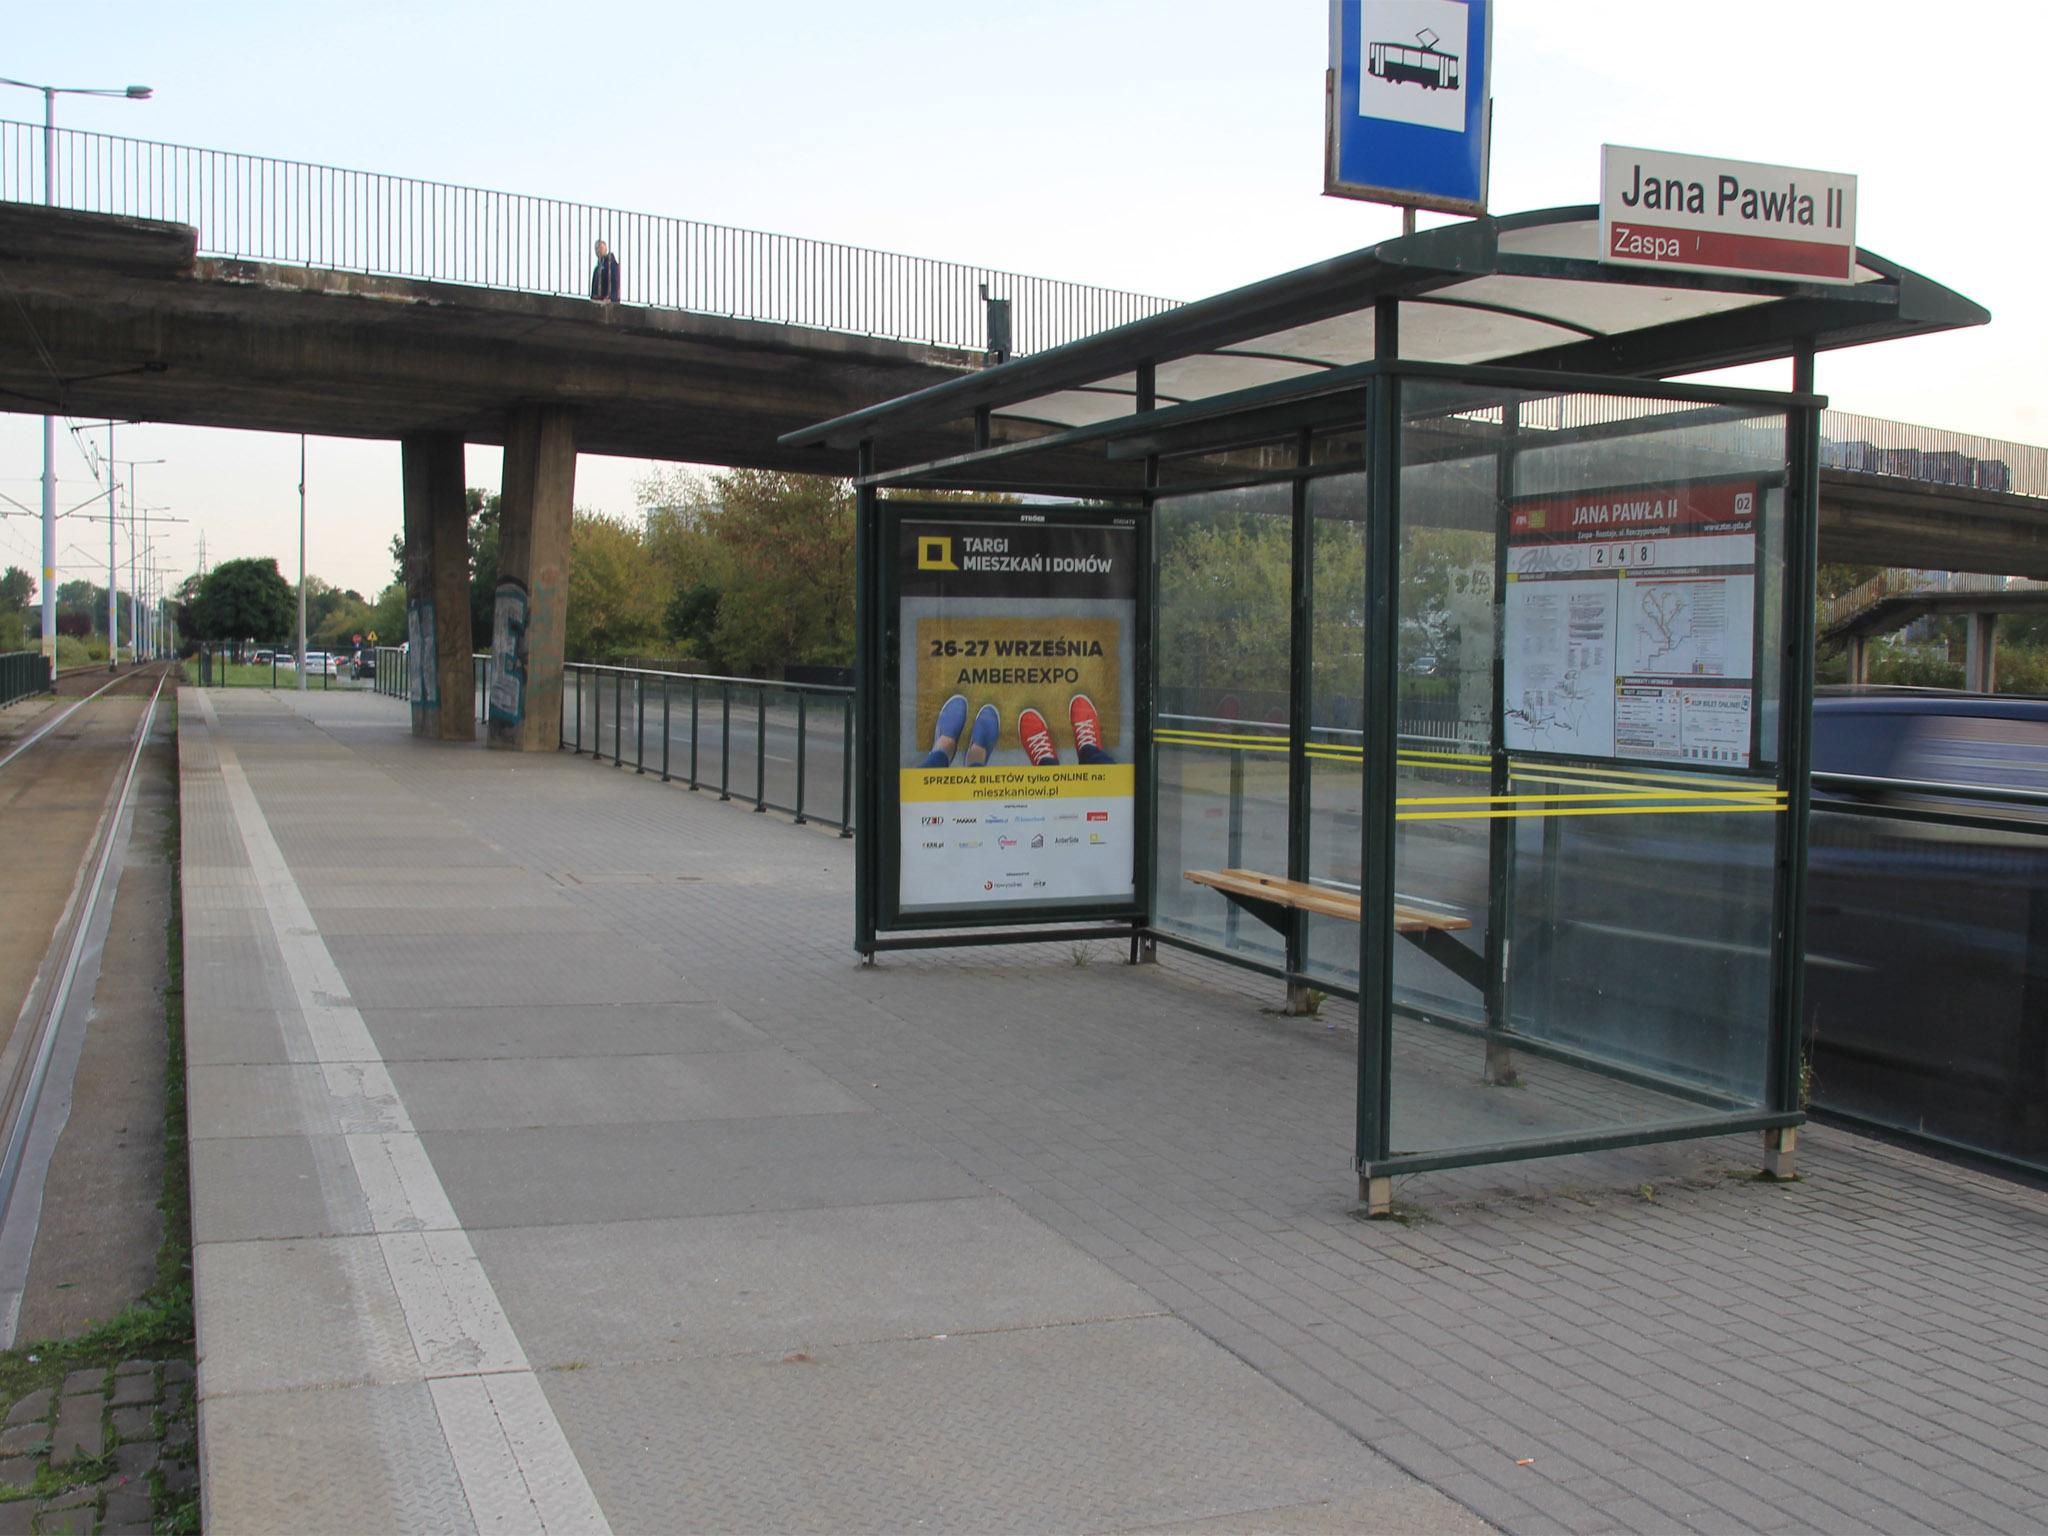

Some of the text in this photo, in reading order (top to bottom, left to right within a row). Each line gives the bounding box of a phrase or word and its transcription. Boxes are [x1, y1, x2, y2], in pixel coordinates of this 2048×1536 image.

[1621, 164, 1843, 229] Jana Pawła II
[1614, 227, 1681, 260] Zaspa
[1572, 499, 1678, 526] JANA PAWŁA II
[1736, 497, 1751, 511] 02
[963, 537, 1009, 553] TARGI
[963, 553, 1113, 574] MIESZKAŃ I DOMÓW
[1596, 549, 1604, 564] 2
[1618, 548, 1625, 563] 4
[1640, 546, 1648, 562] 8
[930, 636, 1104, 658] 26-27 WRZEŚNIA
[957, 667, 1080, 685] AMBEREXPO
[923, 772, 1106, 786] SPRZEDAŻ BILETÓW tylko ONLINE na:
[973, 785, 1059, 798] mieszkaniowi.pl
